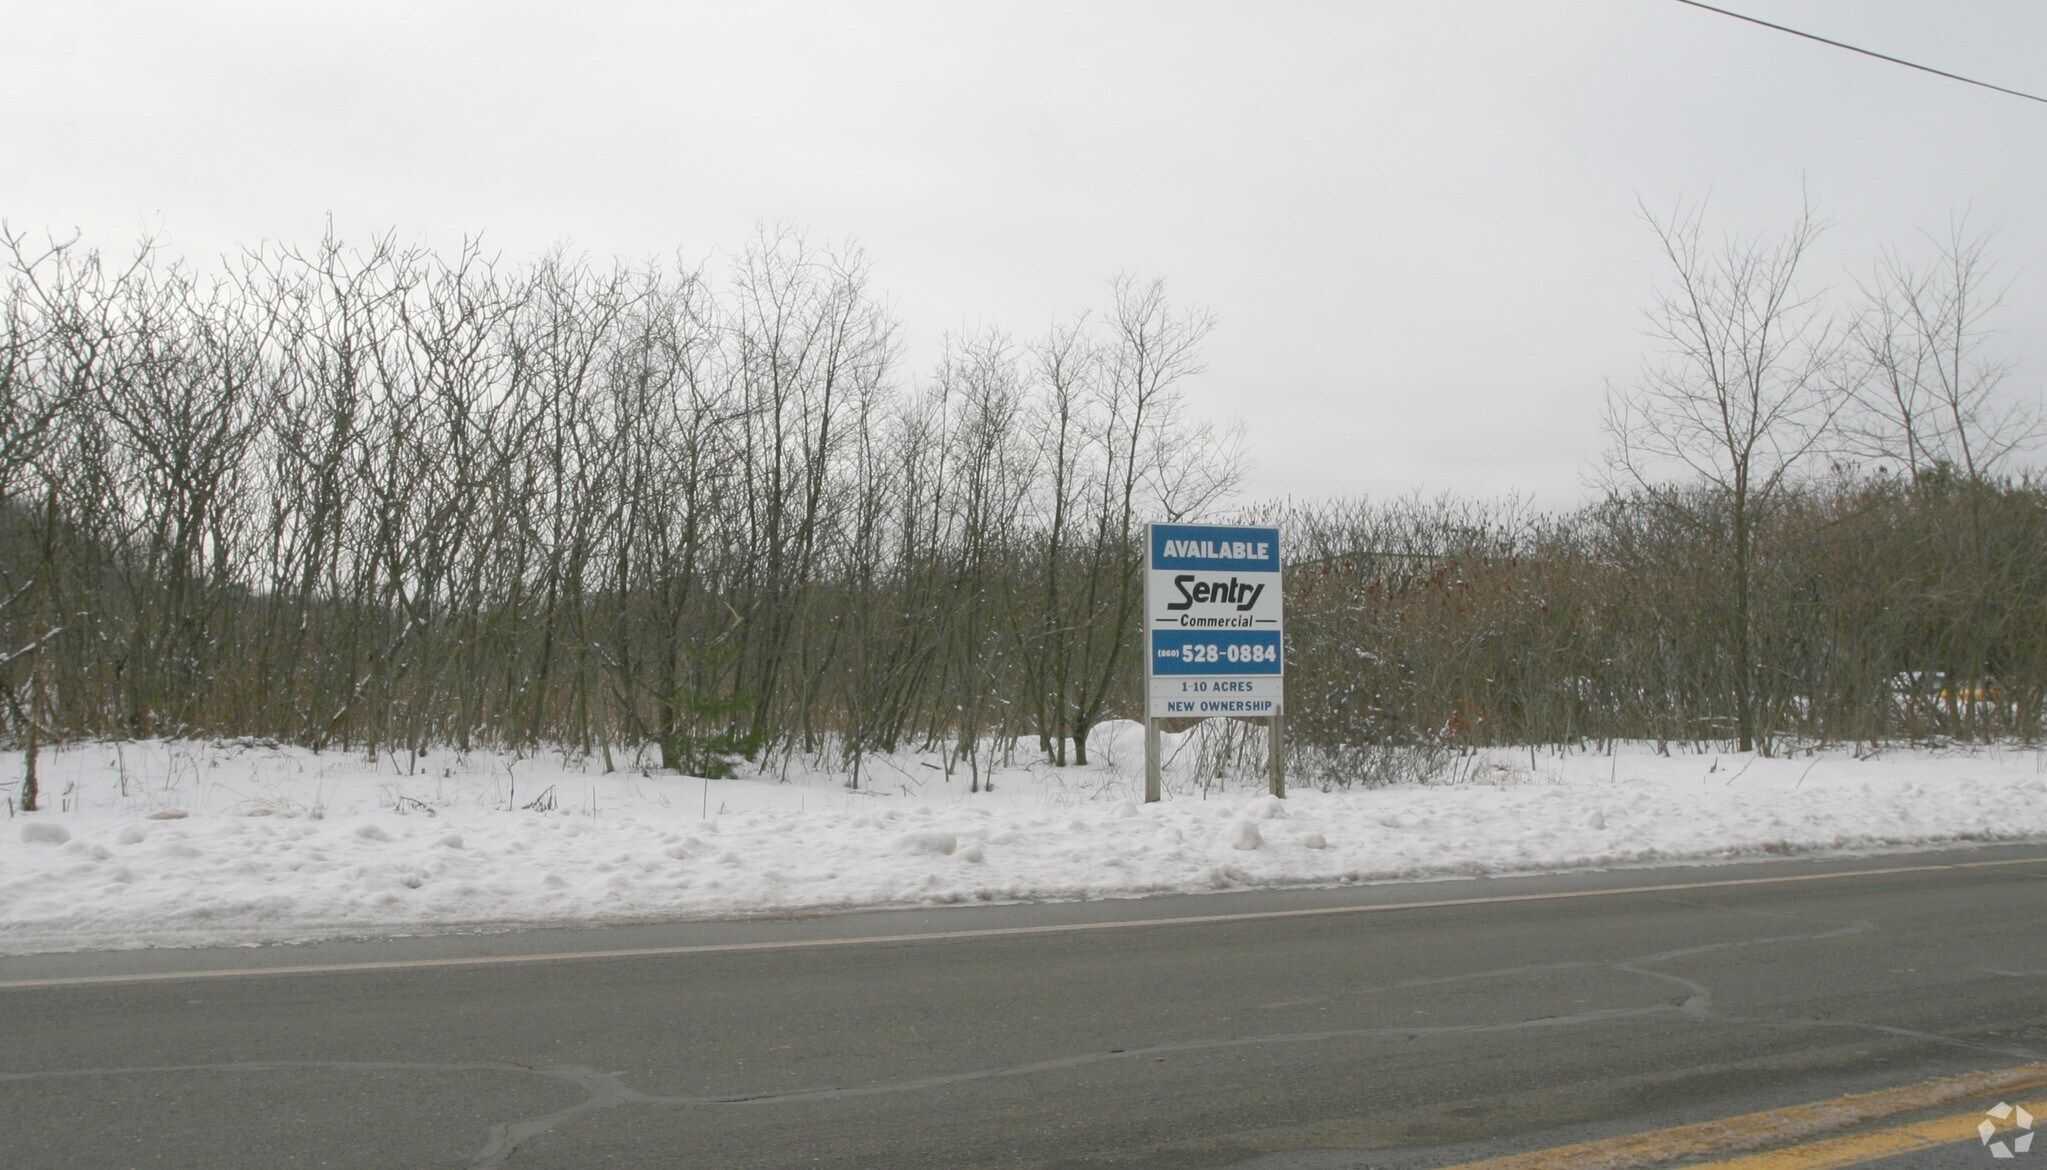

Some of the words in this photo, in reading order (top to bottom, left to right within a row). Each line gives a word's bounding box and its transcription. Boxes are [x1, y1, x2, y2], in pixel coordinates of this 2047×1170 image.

[1163, 540, 1269, 560] AVAILABLE
[1167, 574, 1265, 611] Sentry
[1180, 614, 1253, 627] Commercial
[1182, 644, 1276, 663] 528-0884
[1182, 681, 1207, 692] 1-10
[1212, 681, 1253, 692] ACRES
[1167, 701, 1195, 712] NEW
[1200, 701, 1272, 712] OWNERSHIP
